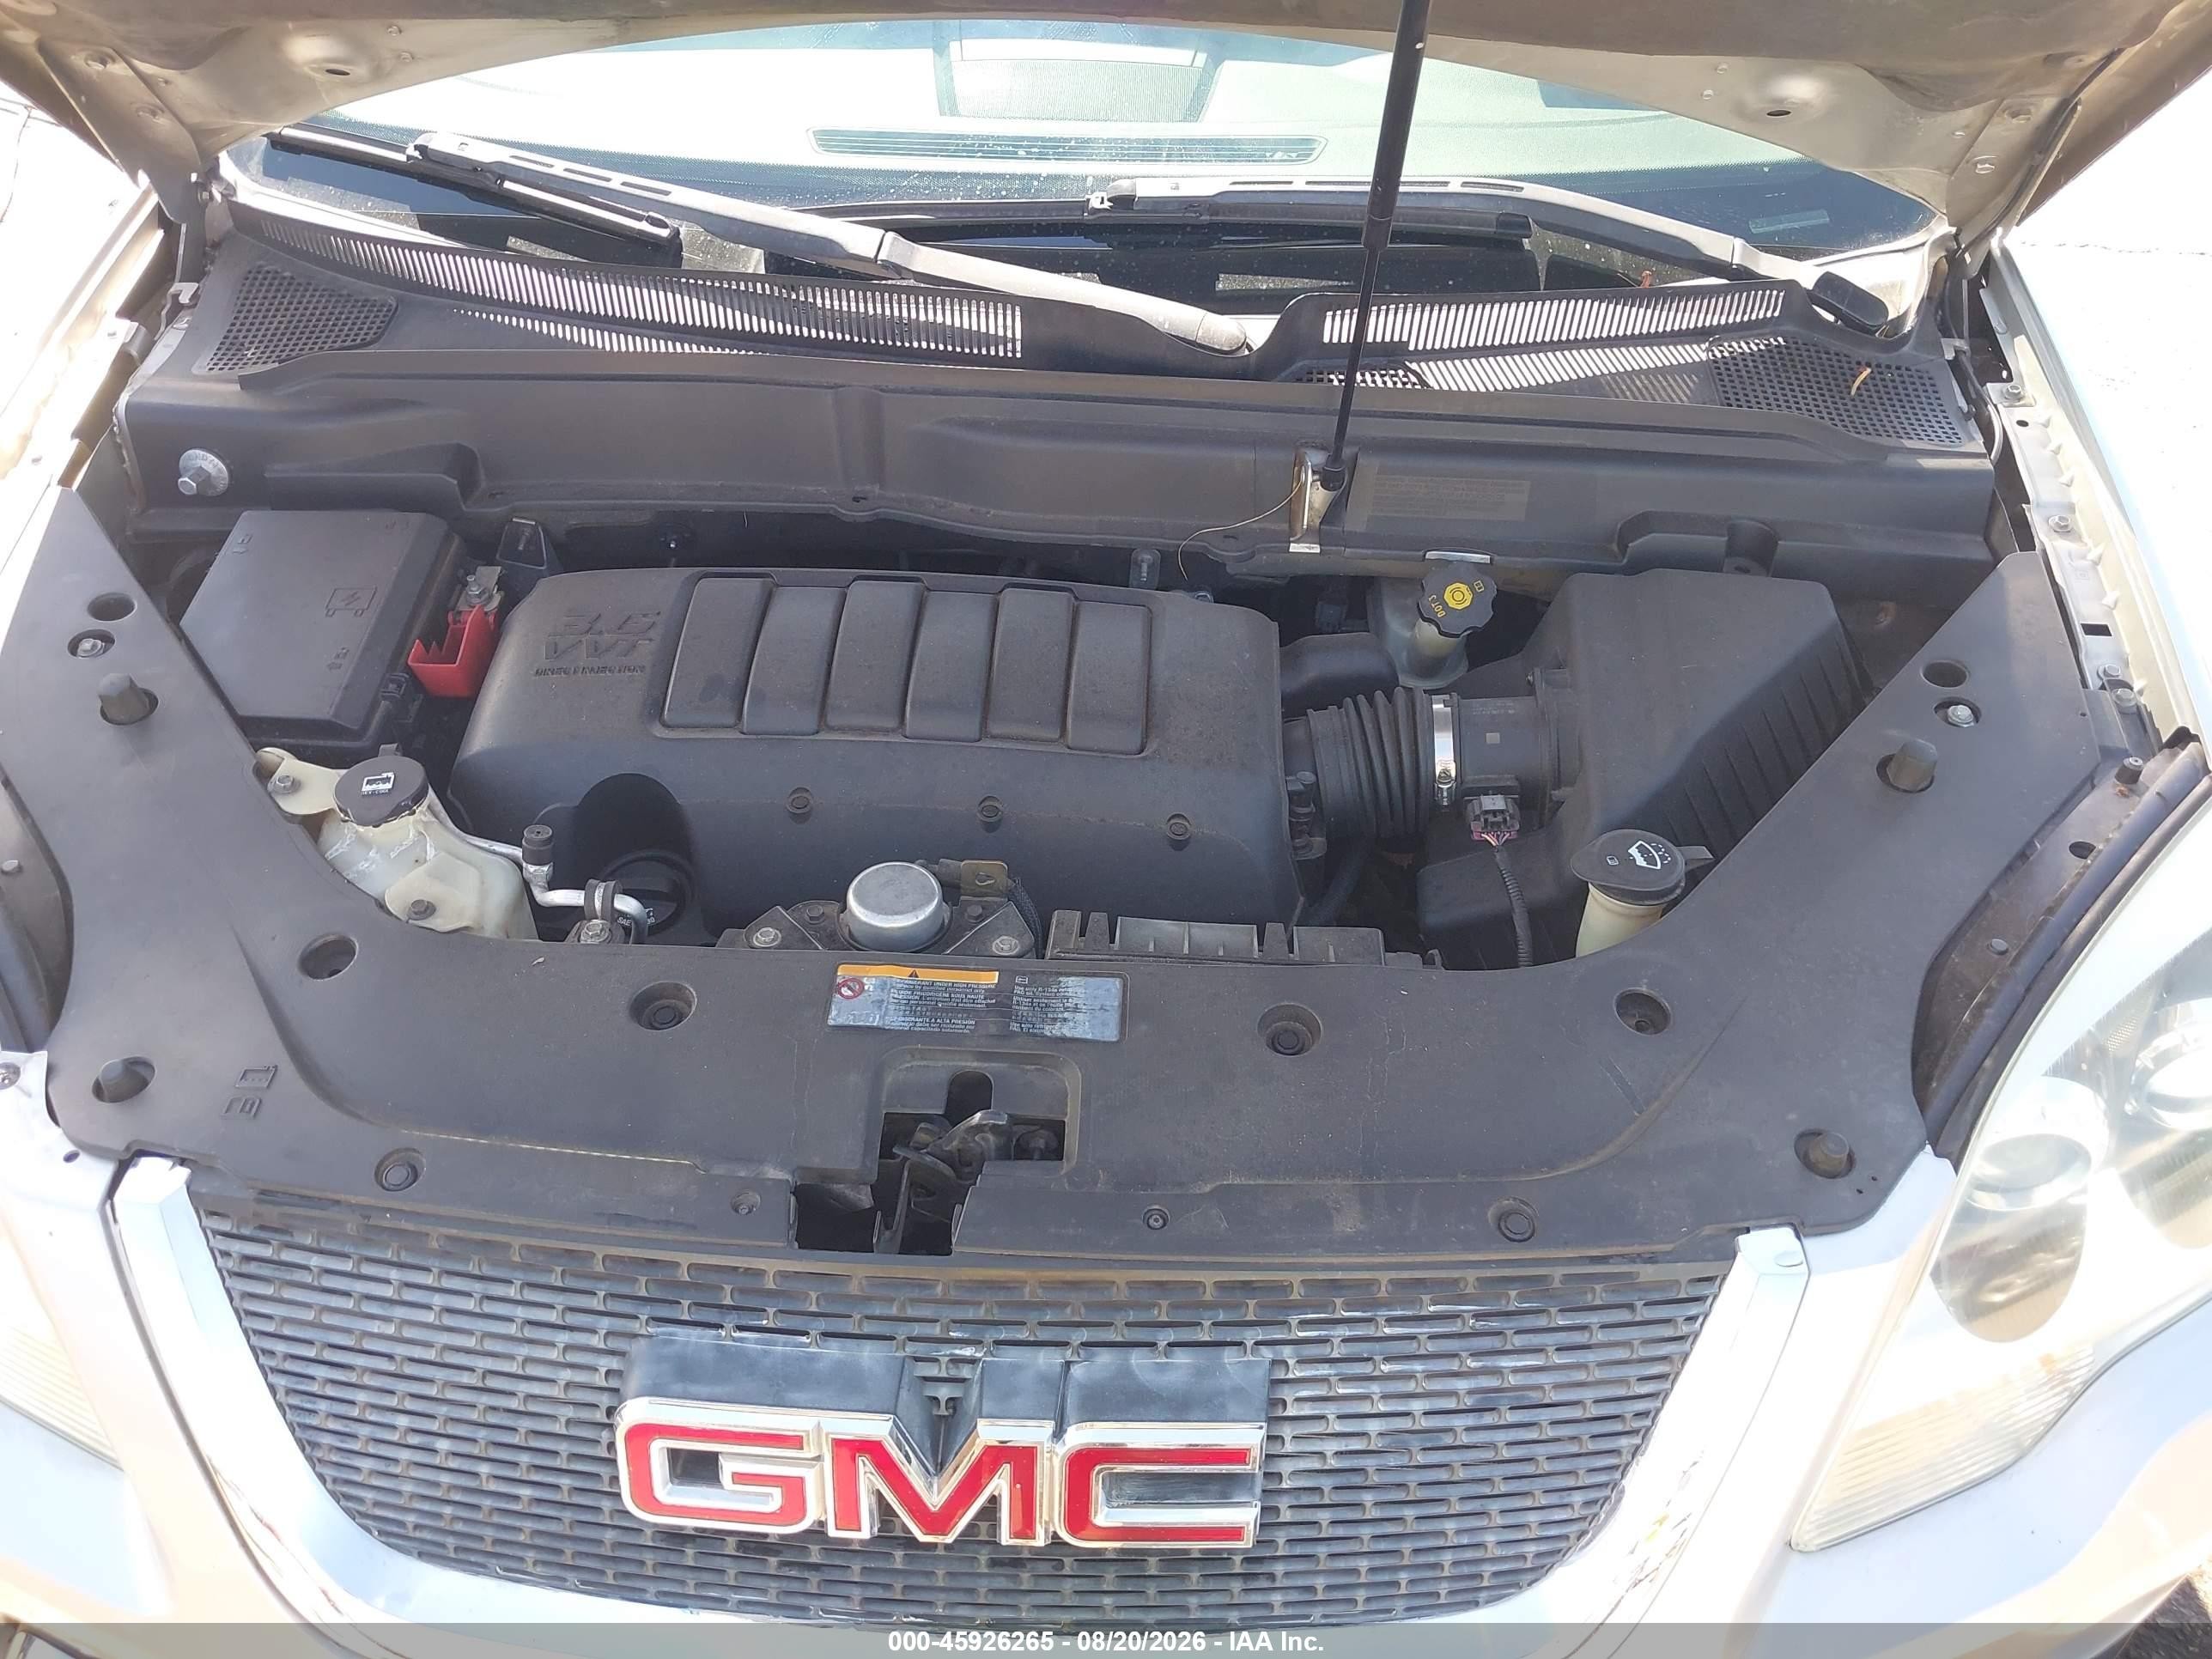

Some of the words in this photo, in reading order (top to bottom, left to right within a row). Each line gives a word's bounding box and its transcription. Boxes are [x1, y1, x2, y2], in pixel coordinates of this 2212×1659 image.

[1431, 602, 1446, 617] DOT
[544, 635, 654, 660] VVT
[617, 916, 632, 926] SAE
[615, 1396, 1267, 1549] GMC
